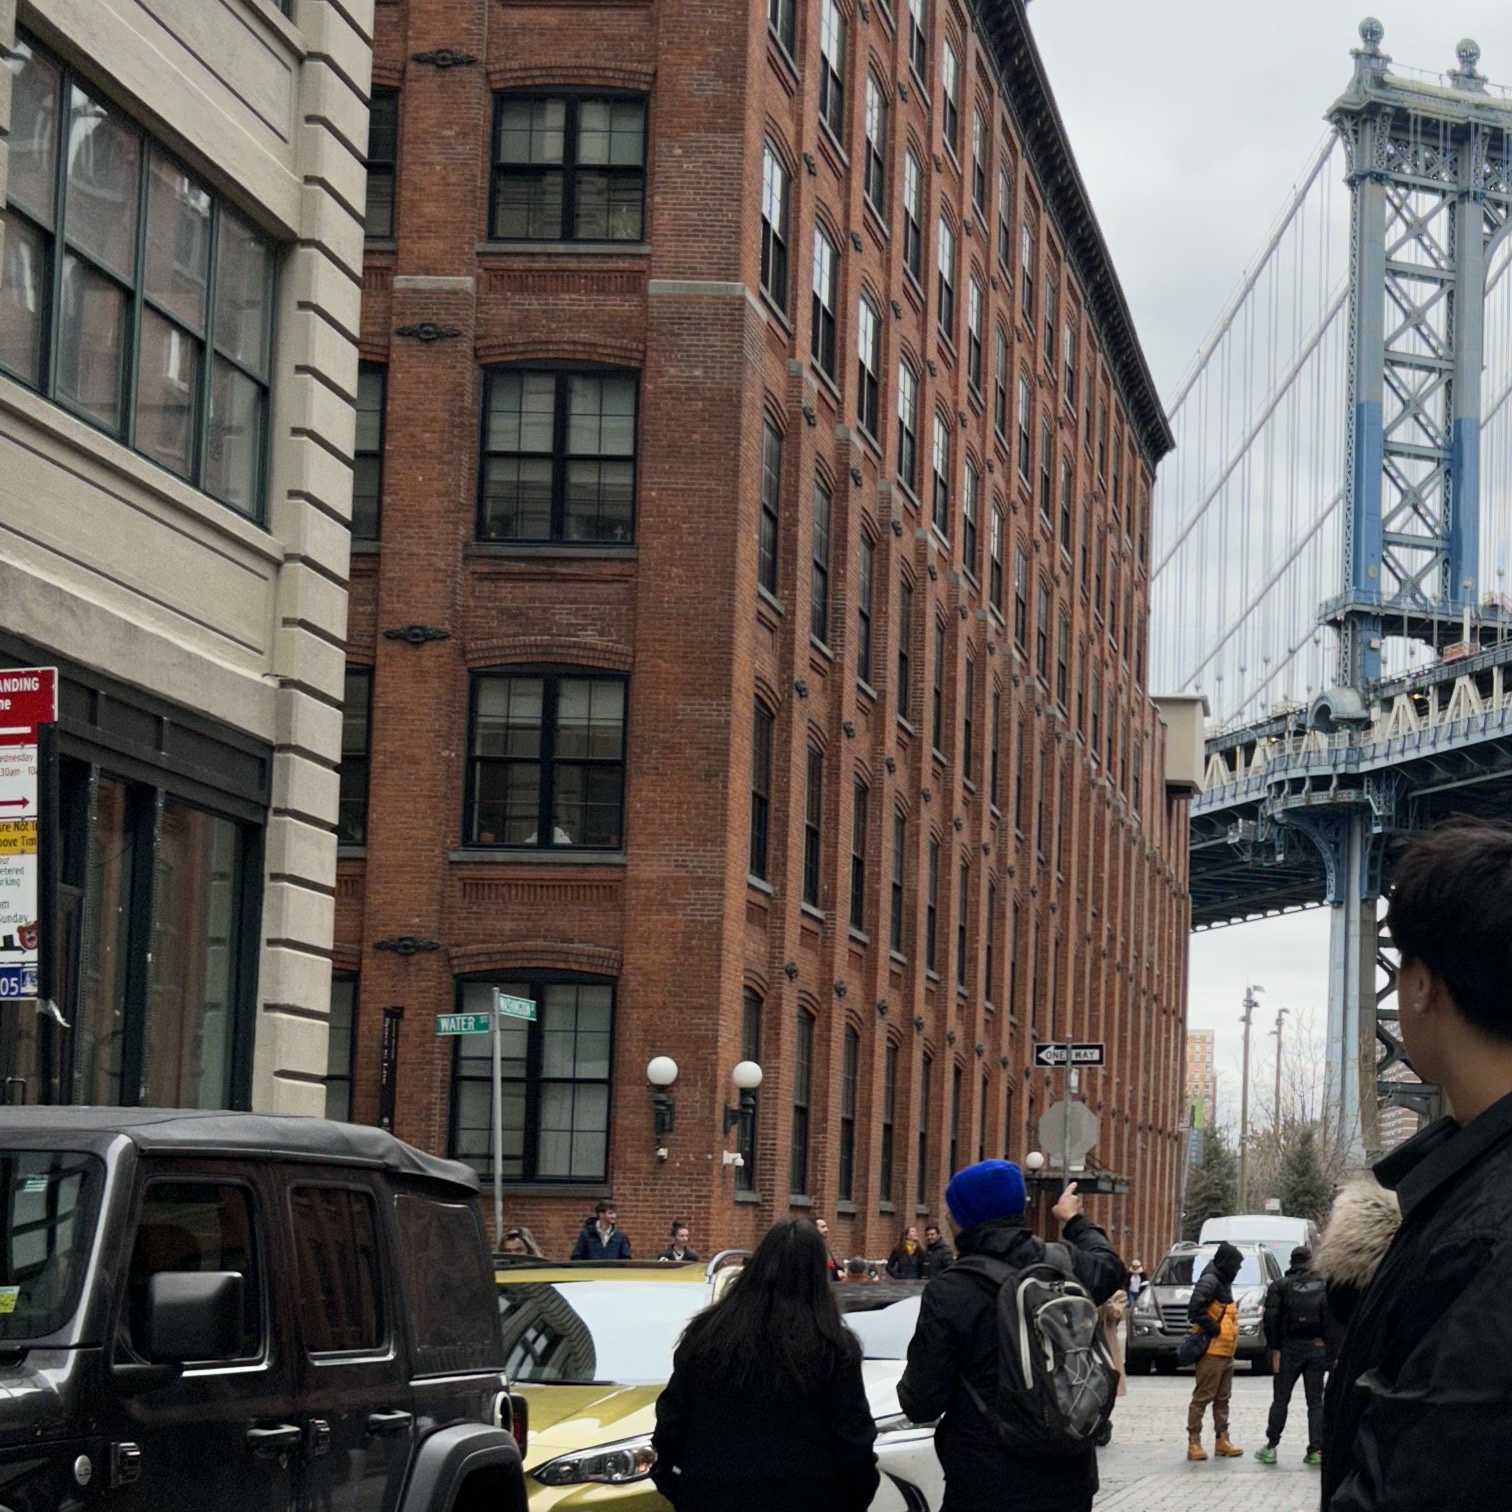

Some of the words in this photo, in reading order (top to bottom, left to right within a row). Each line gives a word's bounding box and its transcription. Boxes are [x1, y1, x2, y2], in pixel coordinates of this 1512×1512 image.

[440, 1016, 475, 1032] WATER
[1045, 1050, 1066, 1060] ONE
[1074, 1050, 1096, 1060] WAY
